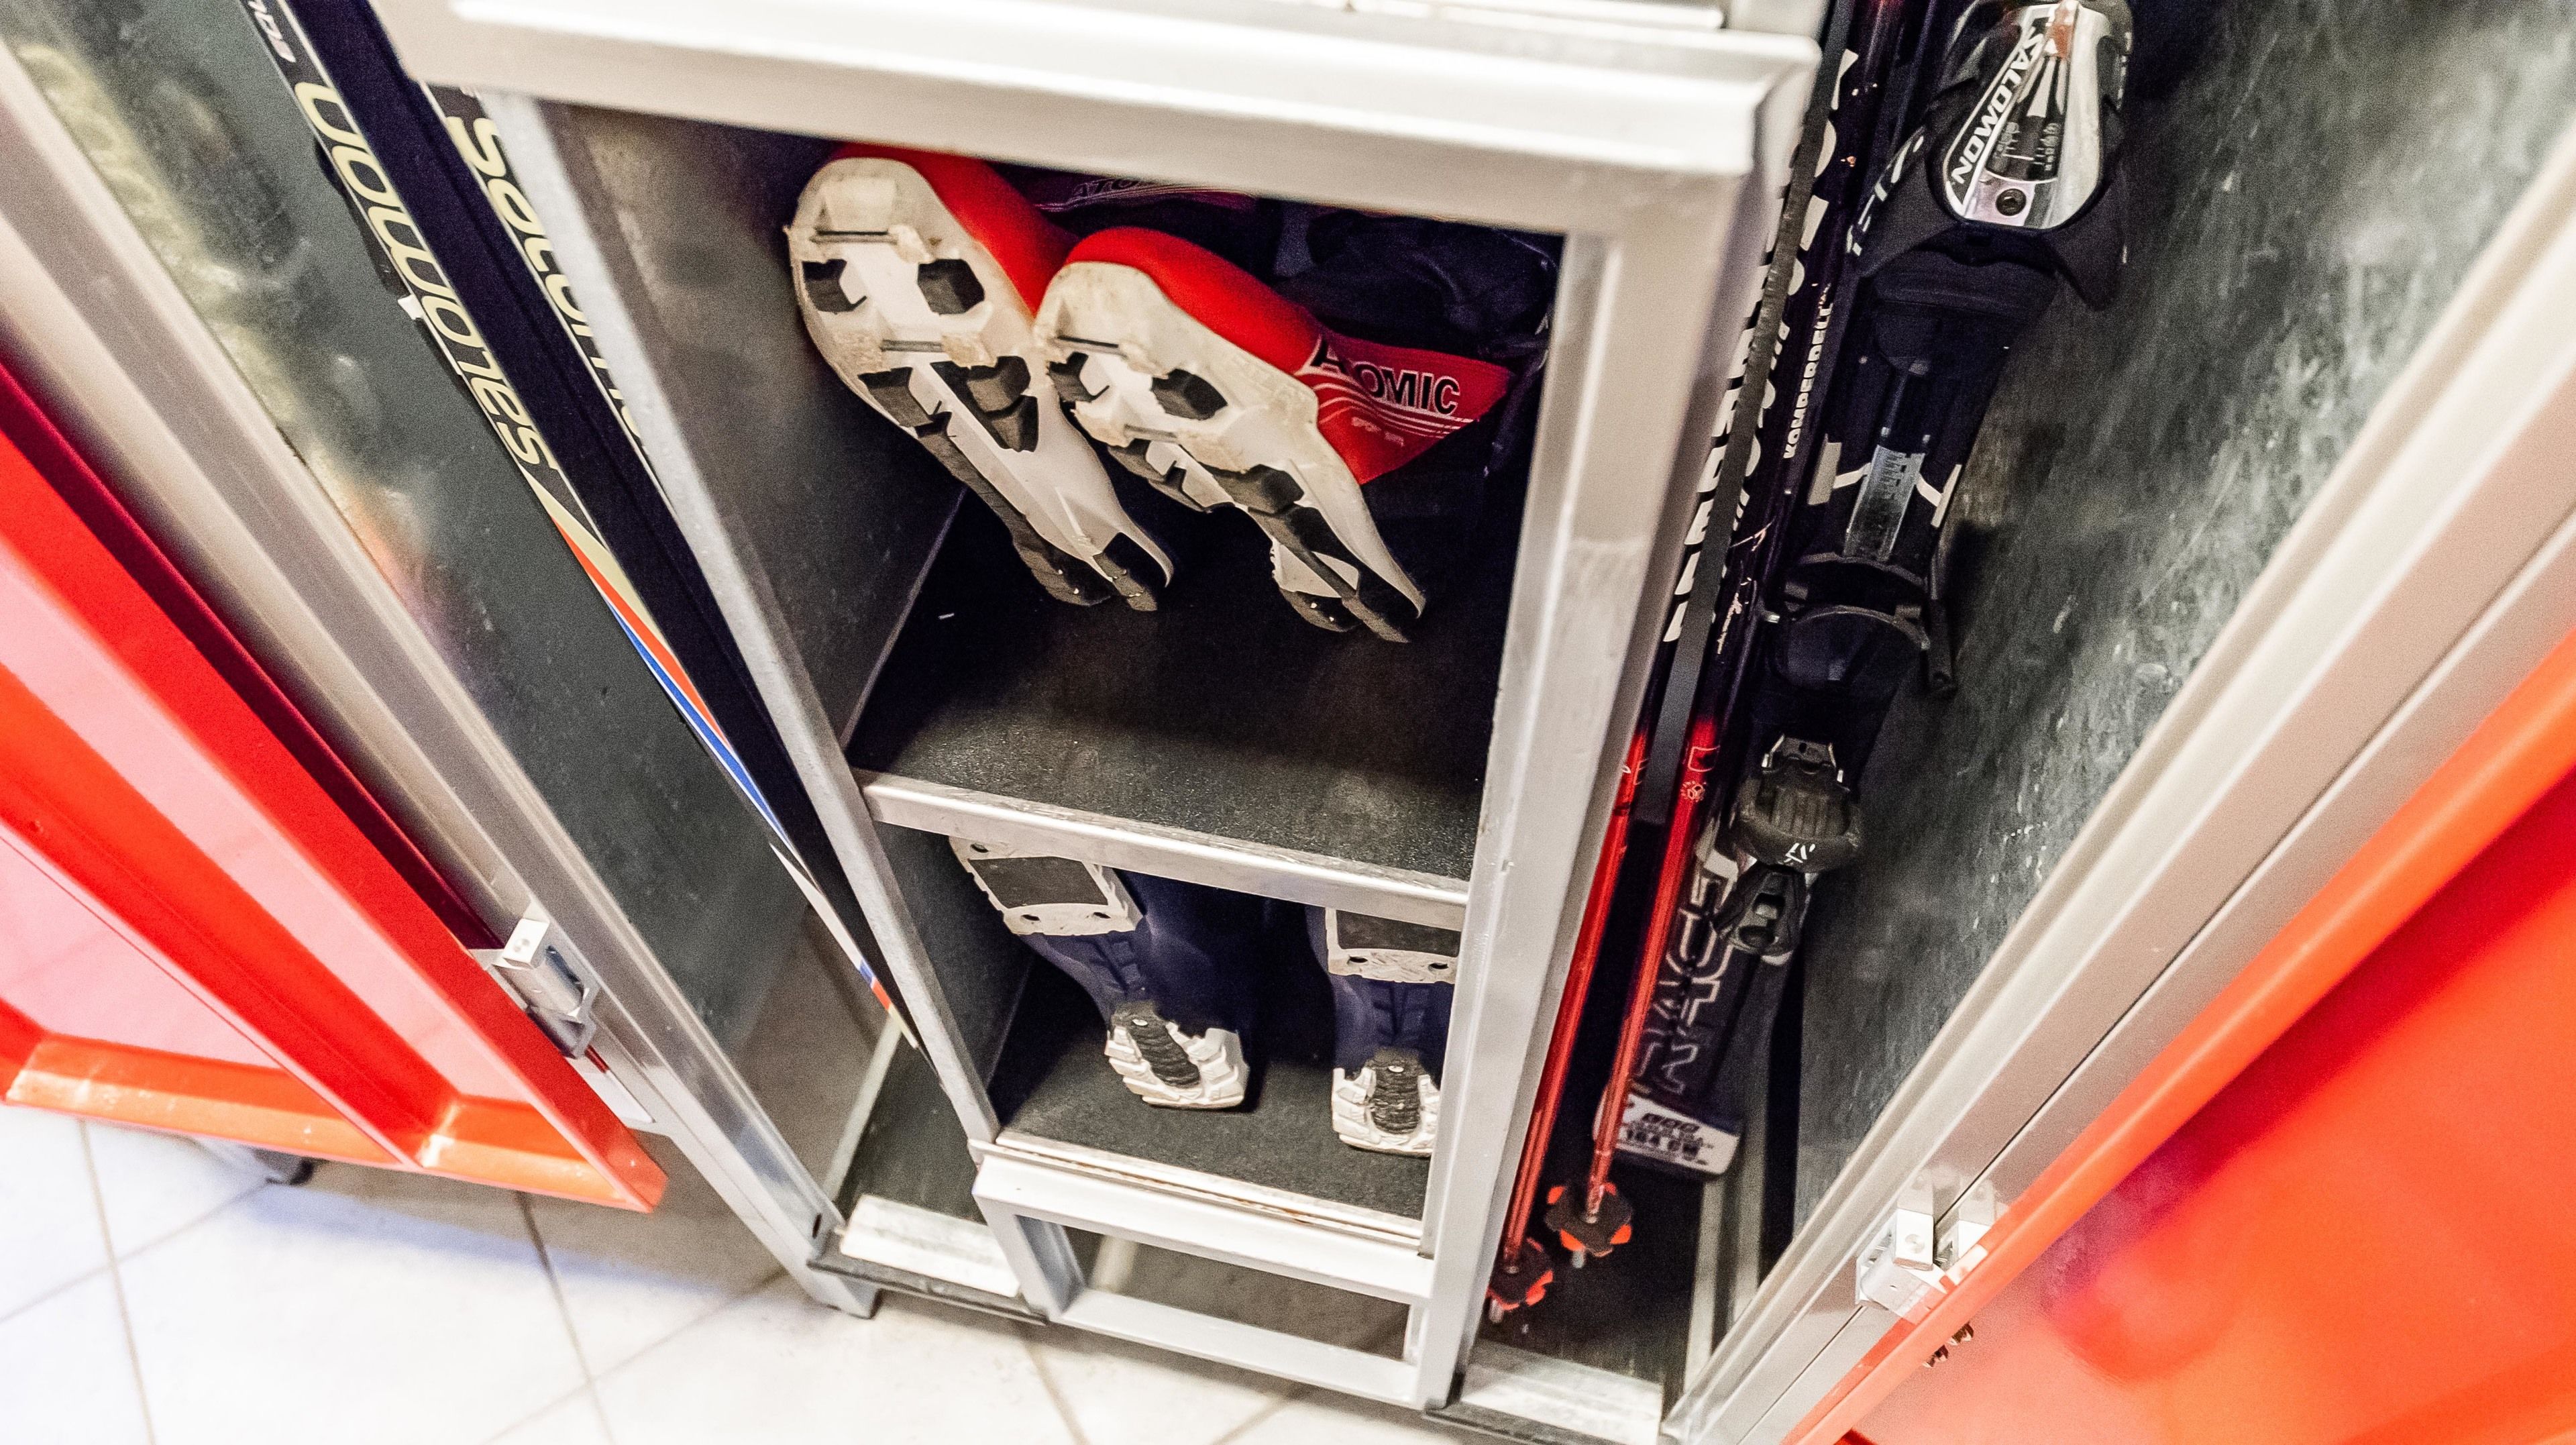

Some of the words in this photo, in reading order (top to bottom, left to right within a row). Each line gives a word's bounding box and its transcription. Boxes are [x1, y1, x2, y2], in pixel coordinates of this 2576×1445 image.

[1951, 27, 2044, 184] SALOMON
[1305, 334, 1460, 415] AOMIC
[1783, 303, 1833, 459] KOMPERDELL
